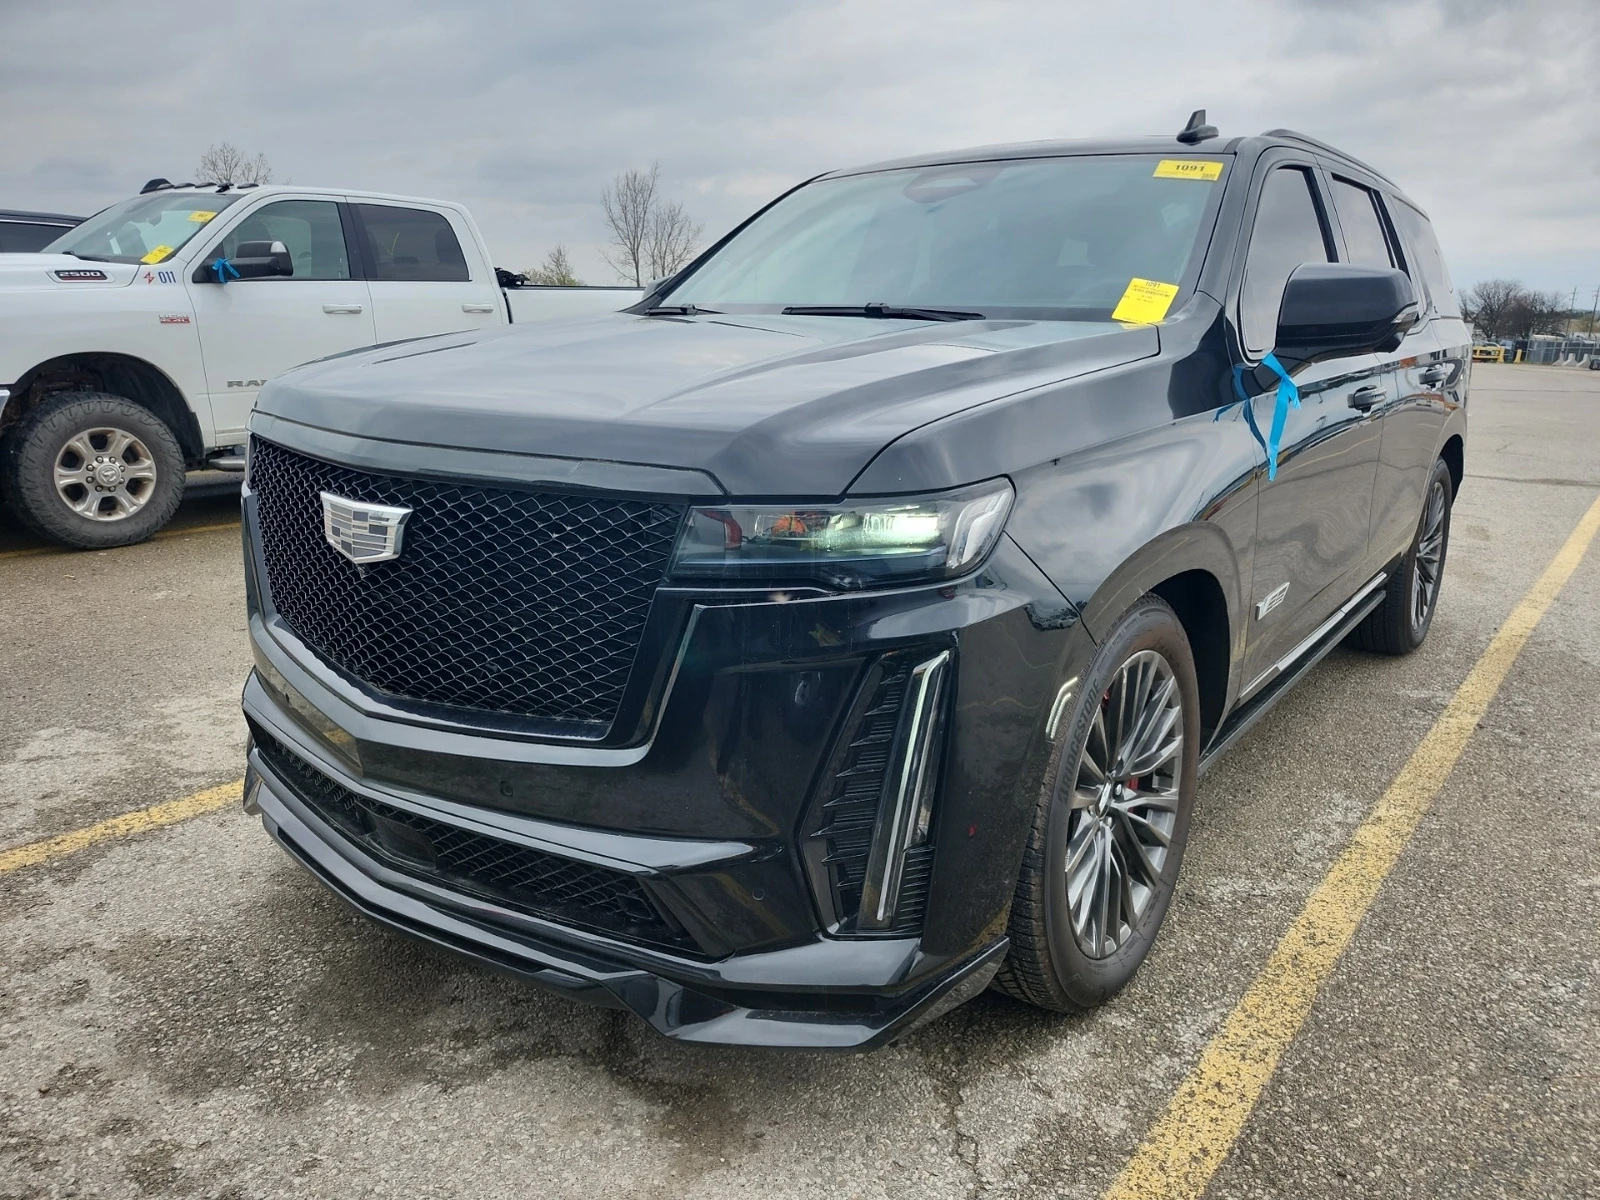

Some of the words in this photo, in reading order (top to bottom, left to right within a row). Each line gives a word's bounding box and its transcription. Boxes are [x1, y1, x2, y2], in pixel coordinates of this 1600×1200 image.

[1174, 164, 1205, 172] 1091
[158, 271, 177, 284] 011
[1058, 678, 1101, 805] BRIDGESTONE
